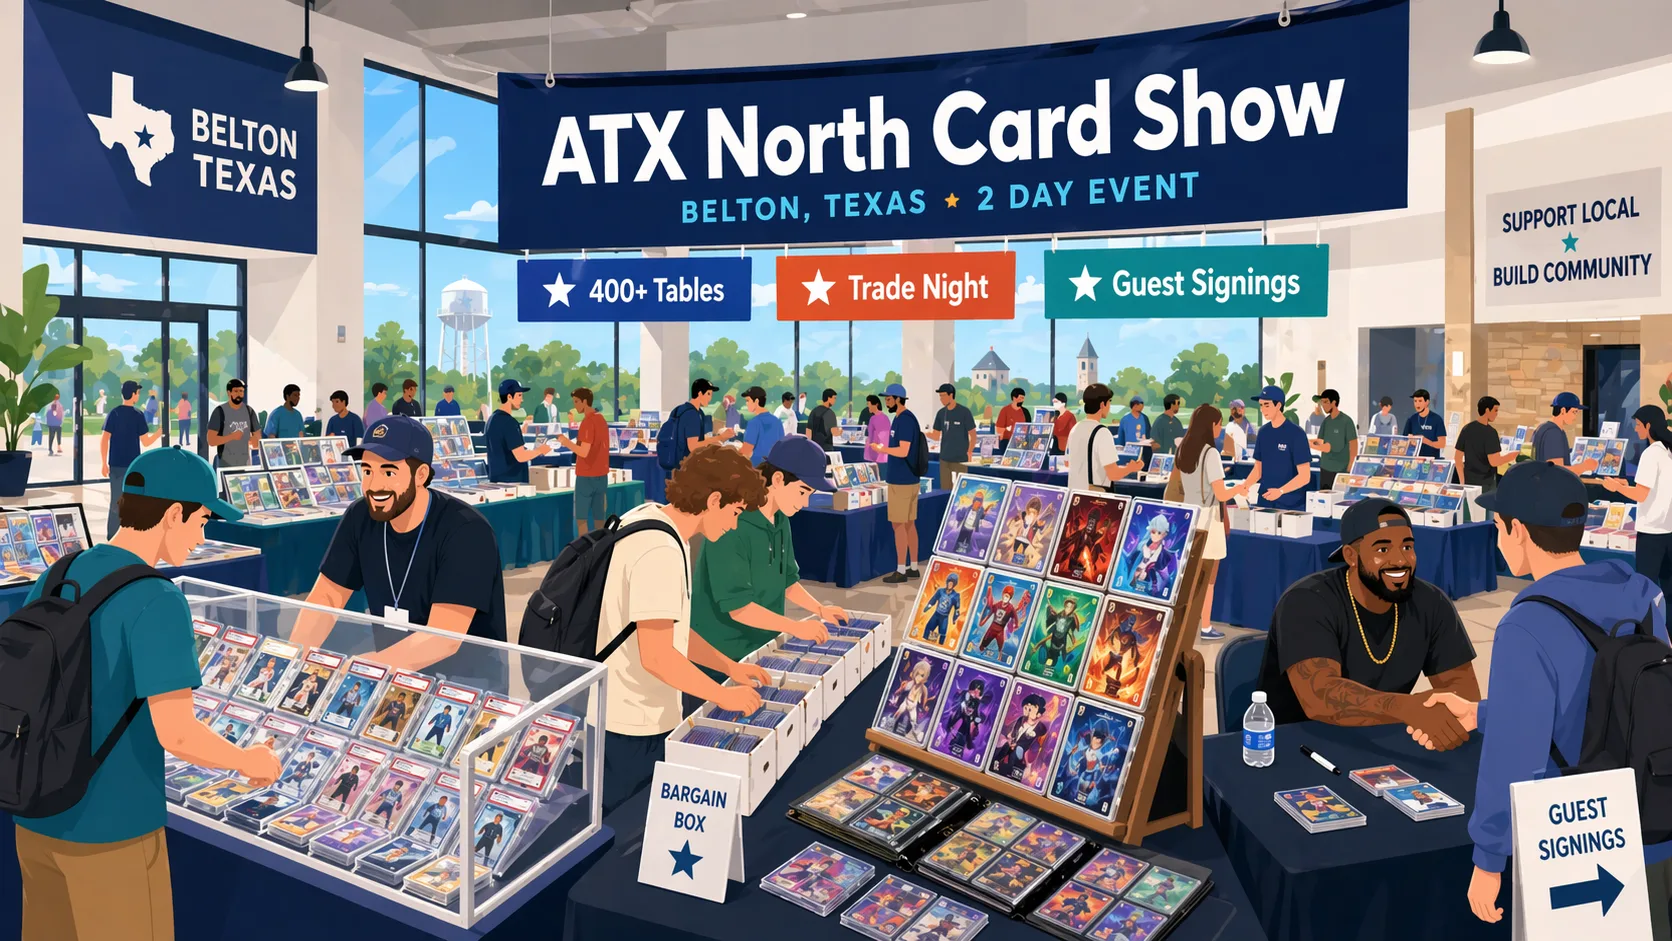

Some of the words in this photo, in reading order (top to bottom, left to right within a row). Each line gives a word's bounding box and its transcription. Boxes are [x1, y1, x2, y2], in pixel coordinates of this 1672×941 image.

[192, 108, 297, 160] BELTON
[542, 109, 687, 186] ATX
[708, 95, 910, 180] North
[933, 78, 1111, 166] Card
[1132, 67, 1346, 151] Show
[193, 152, 297, 201] TEXAS
[682, 195, 810, 224] BELTON,
[823, 189, 926, 218] TEXAS
[977, 185, 994, 211] 2
[1009, 180, 1074, 209] DAY
[1089, 171, 1199, 206] EVENT
[1502, 203, 1578, 234] SUPPORT
[1582, 195, 1640, 224] LOCAL
[1112, 269, 1185, 297] Guest
[1191, 266, 1301, 304] Signings
[1494, 263, 1539, 287] BUILD
[1543, 252, 1653, 283] COMMUNITY
[589, 278, 648, 303] 400+
[652, 276, 725, 303] Tables
[847, 273, 916, 301] Trade
[923, 271, 989, 307] Night
[660, 782, 728, 809] BARGAIN
[1548, 796, 1608, 826] GUEST
[673, 811, 707, 833] BOX
[1538, 827, 1626, 861] SIGNINGS
